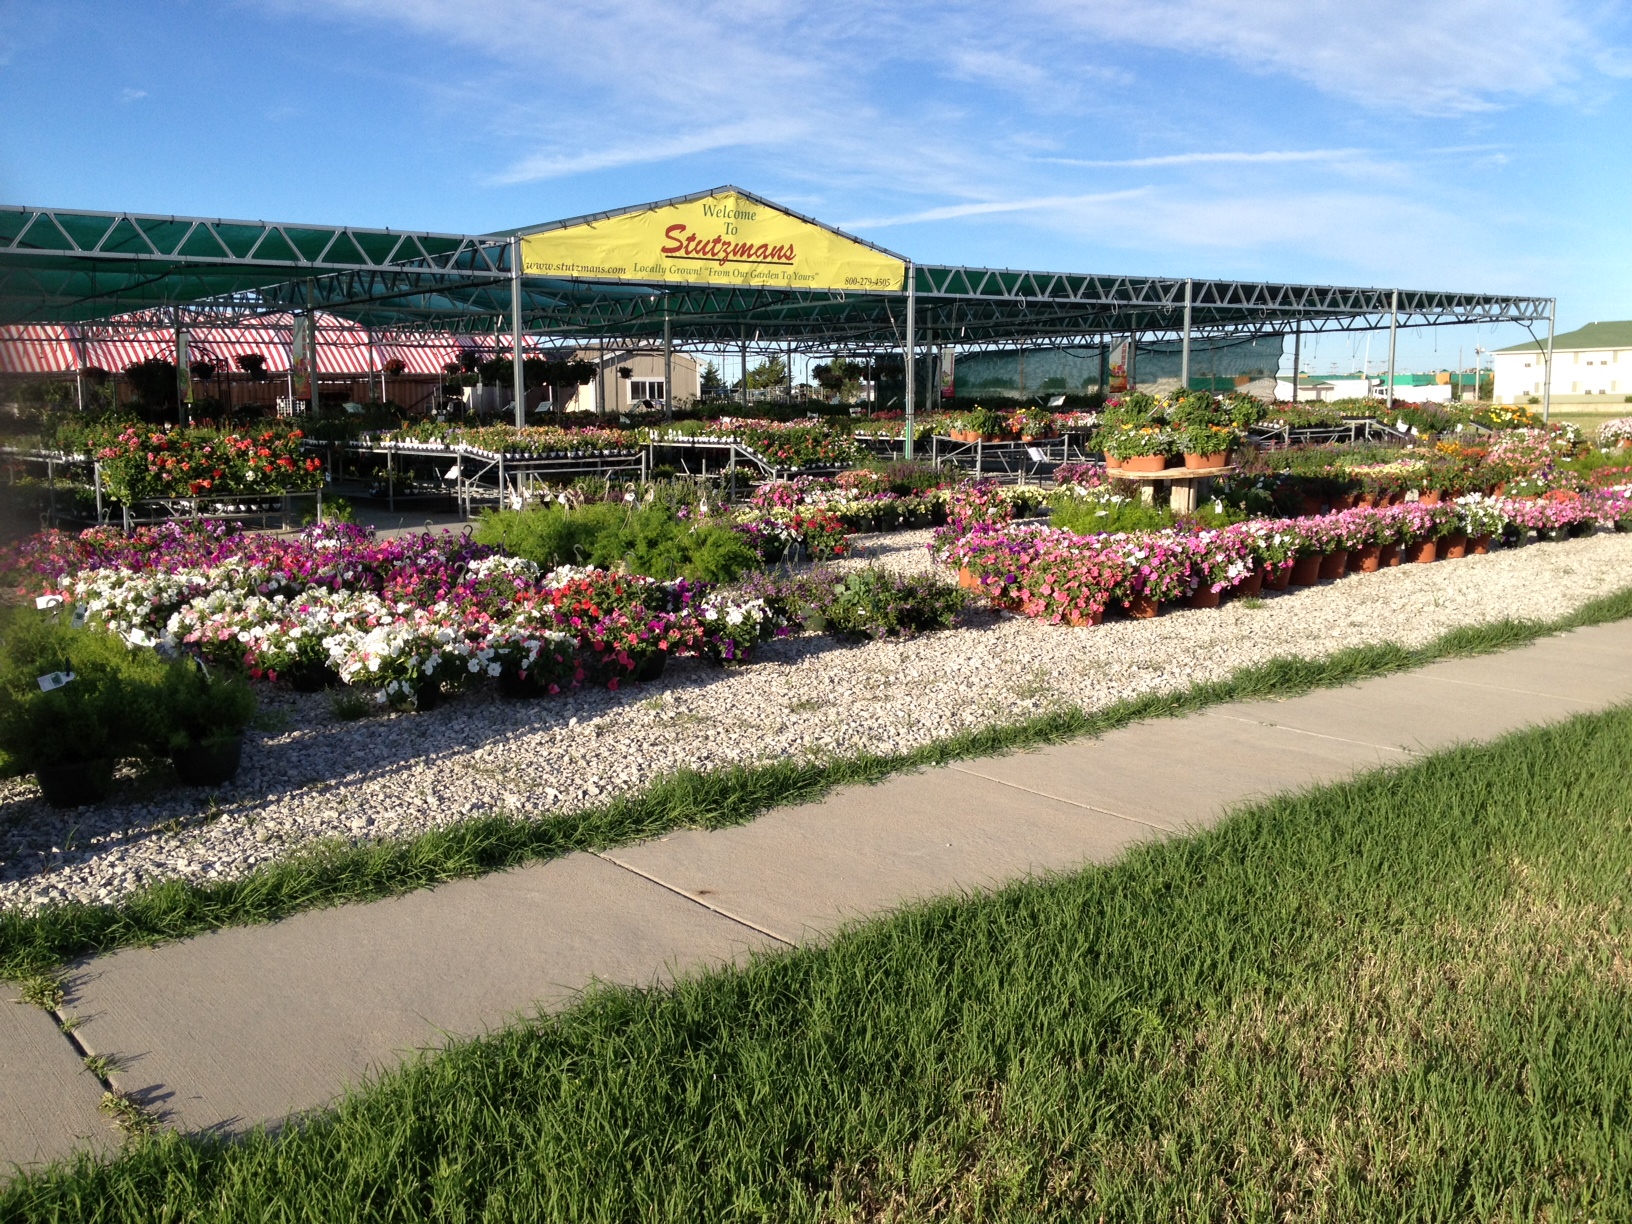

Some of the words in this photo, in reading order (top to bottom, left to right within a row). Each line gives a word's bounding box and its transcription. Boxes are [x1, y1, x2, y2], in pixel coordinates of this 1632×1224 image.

[701, 203, 757, 221] Welcome
[724, 222, 738, 236] To
[660, 223, 797, 267] Stutzmans
[526, 261, 627, 275] www.stutzmans.com
[633, 262, 667, 276] Locally
[668, 263, 702, 276] Grown!
[732, 268, 748, 279] Our
[749, 269, 779, 280] Garden
[781, 271, 792, 281] To
[844, 276, 891, 287] 800-279-4505
